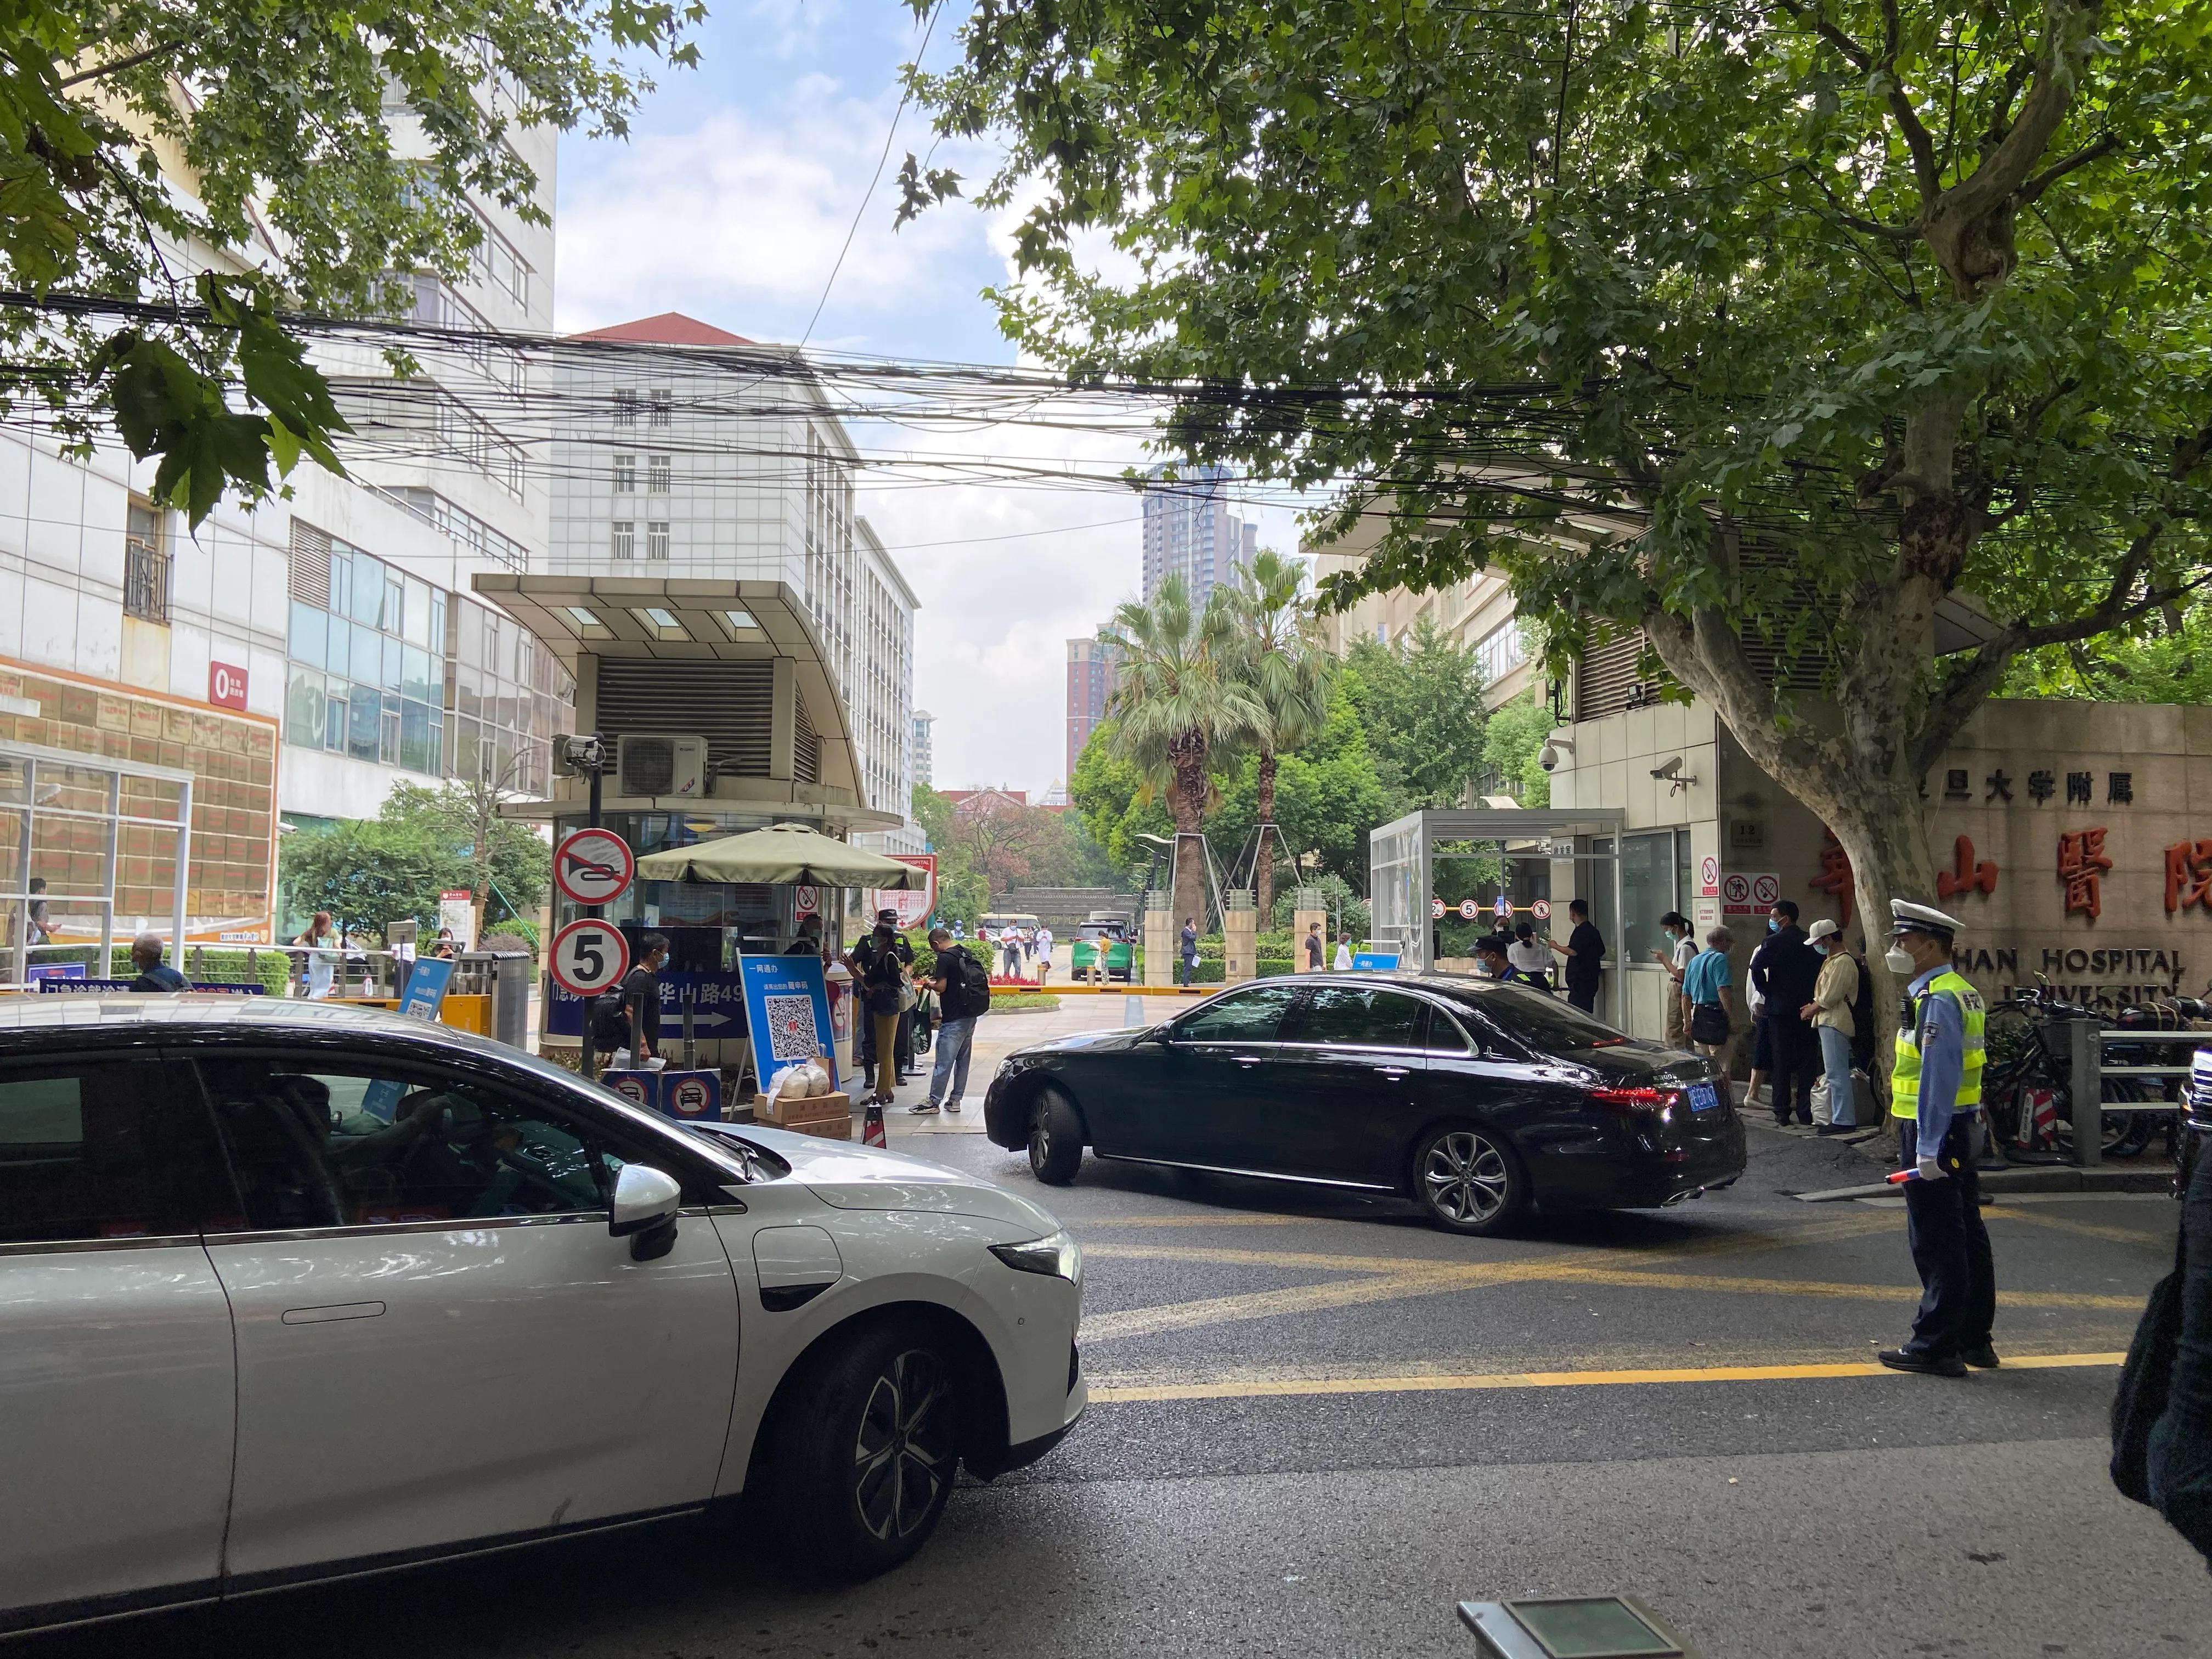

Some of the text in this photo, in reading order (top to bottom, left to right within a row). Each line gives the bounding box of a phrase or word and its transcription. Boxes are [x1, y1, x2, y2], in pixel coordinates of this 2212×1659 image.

[1466, 905, 1472, 915] 5
[572, 934, 605, 982] 5
[1952, 947, 2187, 974] HAN HOSPITAL
[749, 964, 778, 973] 一网通办
